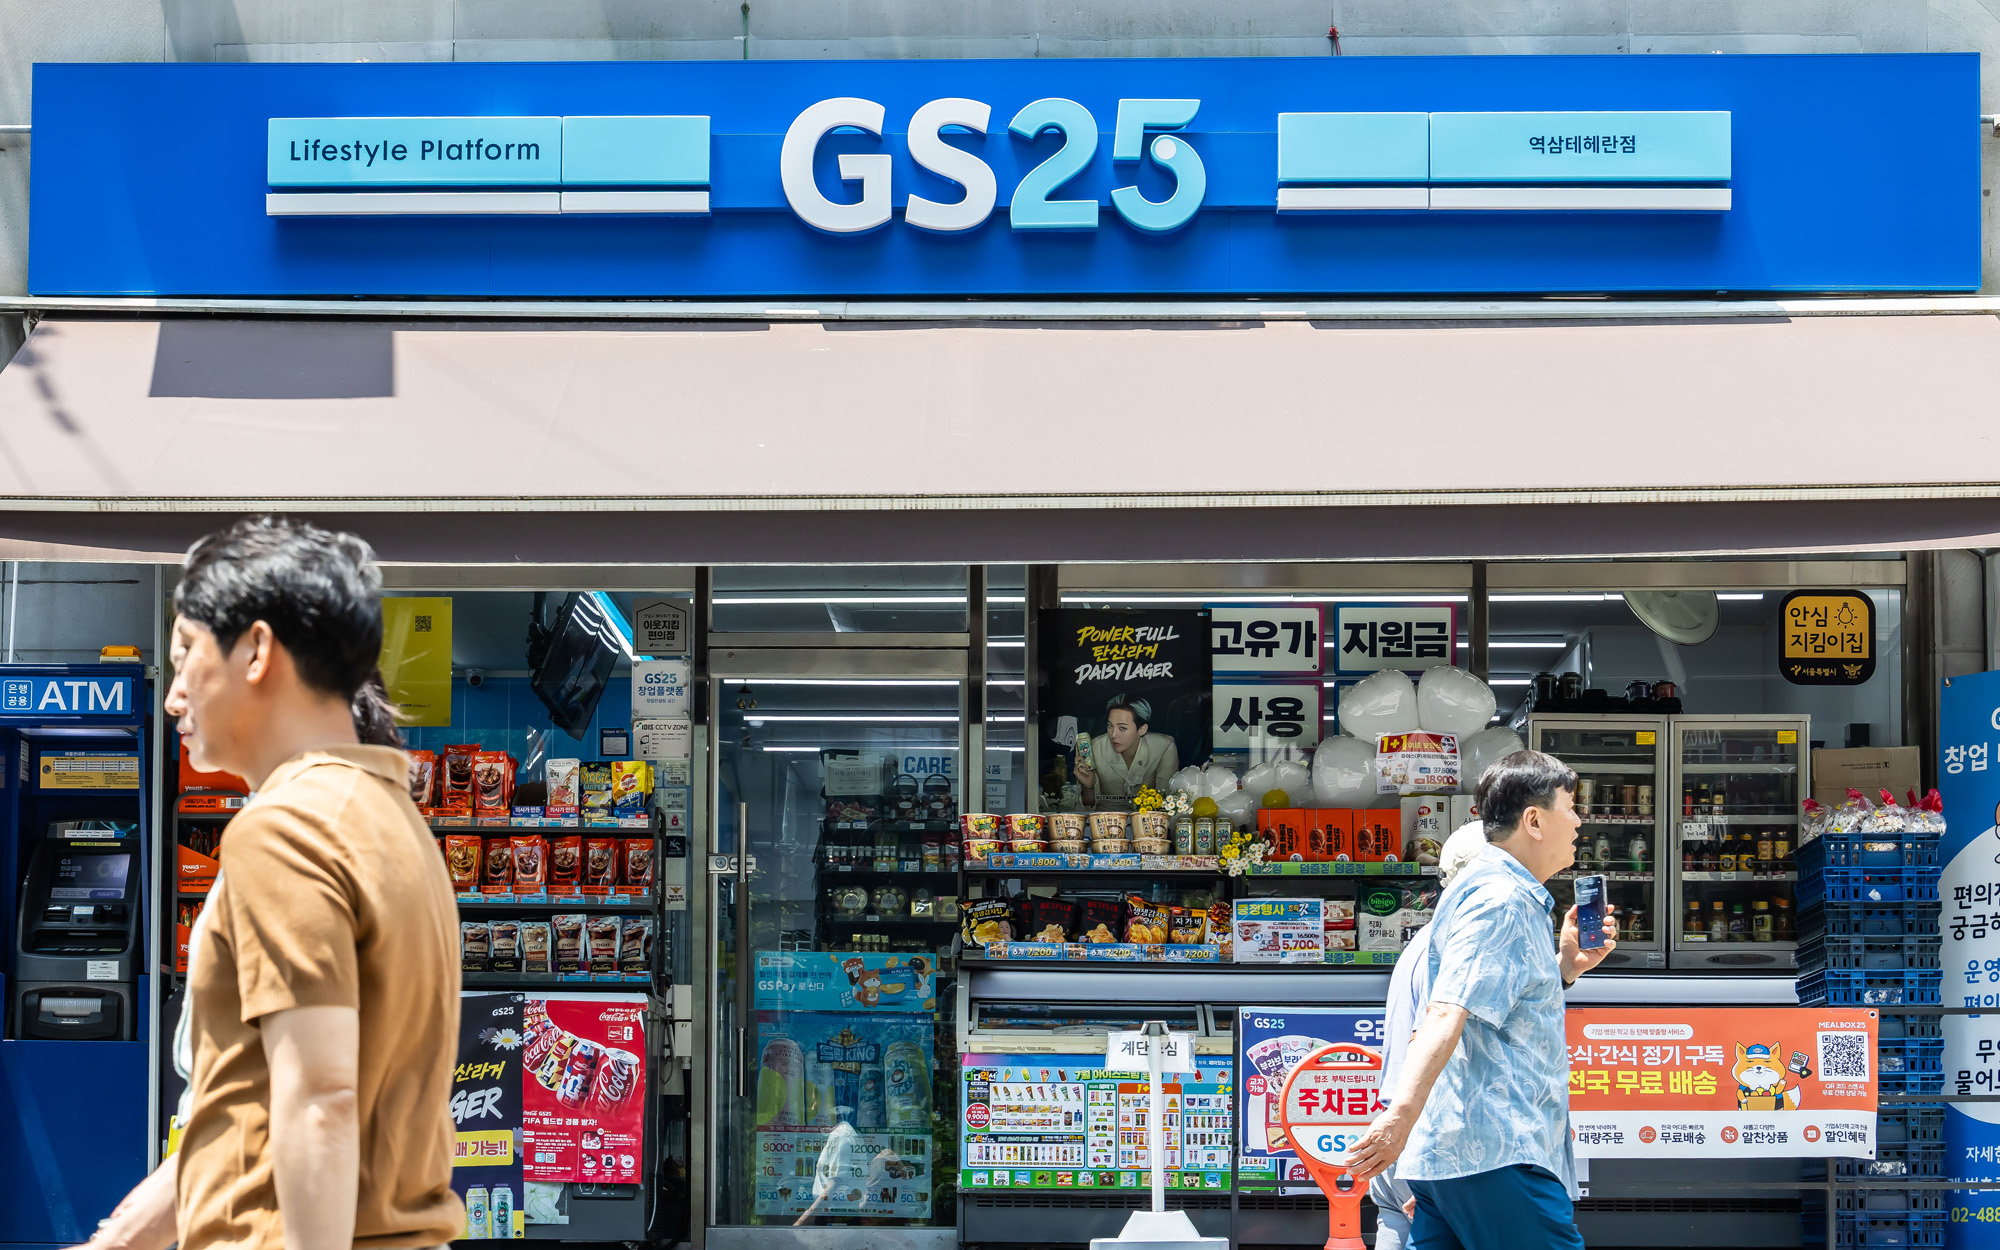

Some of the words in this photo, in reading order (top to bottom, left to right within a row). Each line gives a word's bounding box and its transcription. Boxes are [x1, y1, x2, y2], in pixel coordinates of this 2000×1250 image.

[1528, 135, 1637, 154] 역삼테헤란점
[290, 139, 408, 167] Lifestyle
[421, 138, 541, 161] Platform
[780, 97, 1207, 232] GS25
[1790, 606, 1828, 627] 안심
[643, 620, 679, 630] 이웃지킴
[648, 631, 675, 640] 편의점
[1212, 620, 1317, 658] 고유가
[1342, 621, 1449, 658] 지원금
[1791, 632, 1863, 653] 지킴이집
[1092, 643, 1158, 662] 탄산라거
[1075, 662, 1125, 685] DAISY
[1125, 662, 1173, 681] LAGER
[1802, 668, 1836, 676] 서울특별시
[644, 673, 677, 684] GS25
[8, 684, 27, 694] 은행
[638, 686, 684, 696] 창업플랫폼
[8, 696, 27, 706] 공용
[38, 681, 123, 710] ATM
[1220, 697, 1305, 737] 사용
[1381, 735, 1407, 752] 1+1
[1945, 742, 1988, 775] 창업
[904, 756, 951, 774] CARE
[1411, 818, 1438, 831] 삼계탕
[1300, 864, 1330, 874] 덤증정
[1334, 863, 1366, 874] 덤증정
[1382, 863, 1414, 874] 덤증정
[1040, 902, 1072, 912] NETFLIX
[1088, 901, 1119, 912] NETFLIX
[1370, 898, 1394, 908] bibigo
[1237, 904, 1285, 916] 증정행사
[1368, 920, 1383, 929] 직화
[1012, 947, 1025, 956] 6개
[1090, 948, 1103, 957] 6개
[1169, 951, 1182, 959] 6개
[808, 982, 825, 991] 산다
[492, 1007, 514, 1016] GS25
[1254, 1018, 1286, 1029] GS25
[1121, 1041, 1178, 1057] 계단심
[1642, 1045, 1681, 1066] 정기
[1684, 1045, 1725, 1066] 구독
[452, 1061, 506, 1083] 산라거
[1074, 1070, 1091, 1081] 7월
[1250, 1078, 1265, 1086] 교차
[1332, 1075, 1376, 1083] 부탁드립니다
[1568, 1070, 1611, 1095] 전국
[1616, 1070, 1665, 1095] 무료
[1669, 1070, 1718, 1095] 배송
[1578, 1132, 1625, 1145] 대량주문
[1660, 1132, 1707, 1145] 무료배송
[1742, 1132, 1789, 1144] 알찬상품
[1824, 1130, 1867, 1145] 할인혜택
[471, 1140, 508, 1156] 가능!!
[1292, 1168, 1306, 1176] 교차
